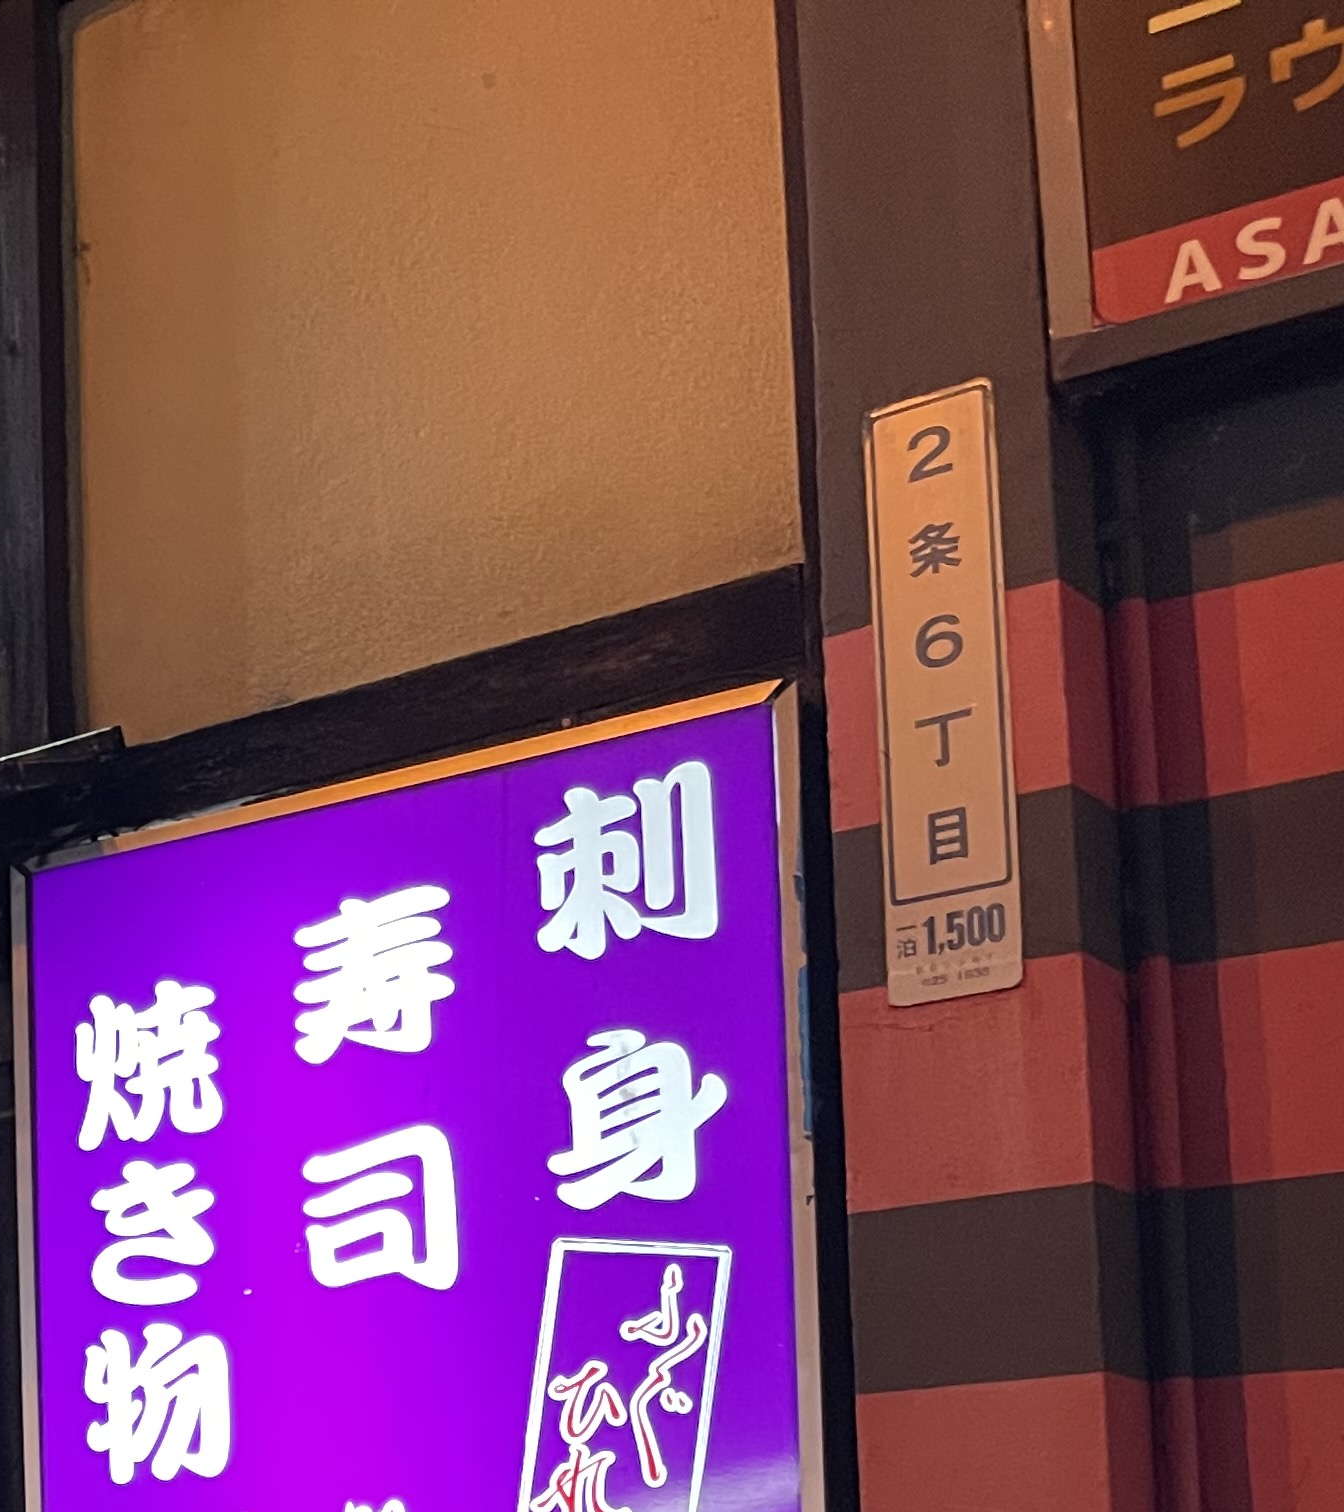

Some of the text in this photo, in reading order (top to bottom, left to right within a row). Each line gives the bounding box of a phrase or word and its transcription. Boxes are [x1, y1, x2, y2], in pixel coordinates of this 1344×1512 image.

[1164, 197, 1344, 304] ASA
[906, 423, 973, 866] 2条6丁目
[294, 885, 460, 1290] 寿司
[533, 759, 727, 1211] 刺身
[921, 902, 1006, 955] 1,500
[74, 980, 233, 1484] 焼き物
